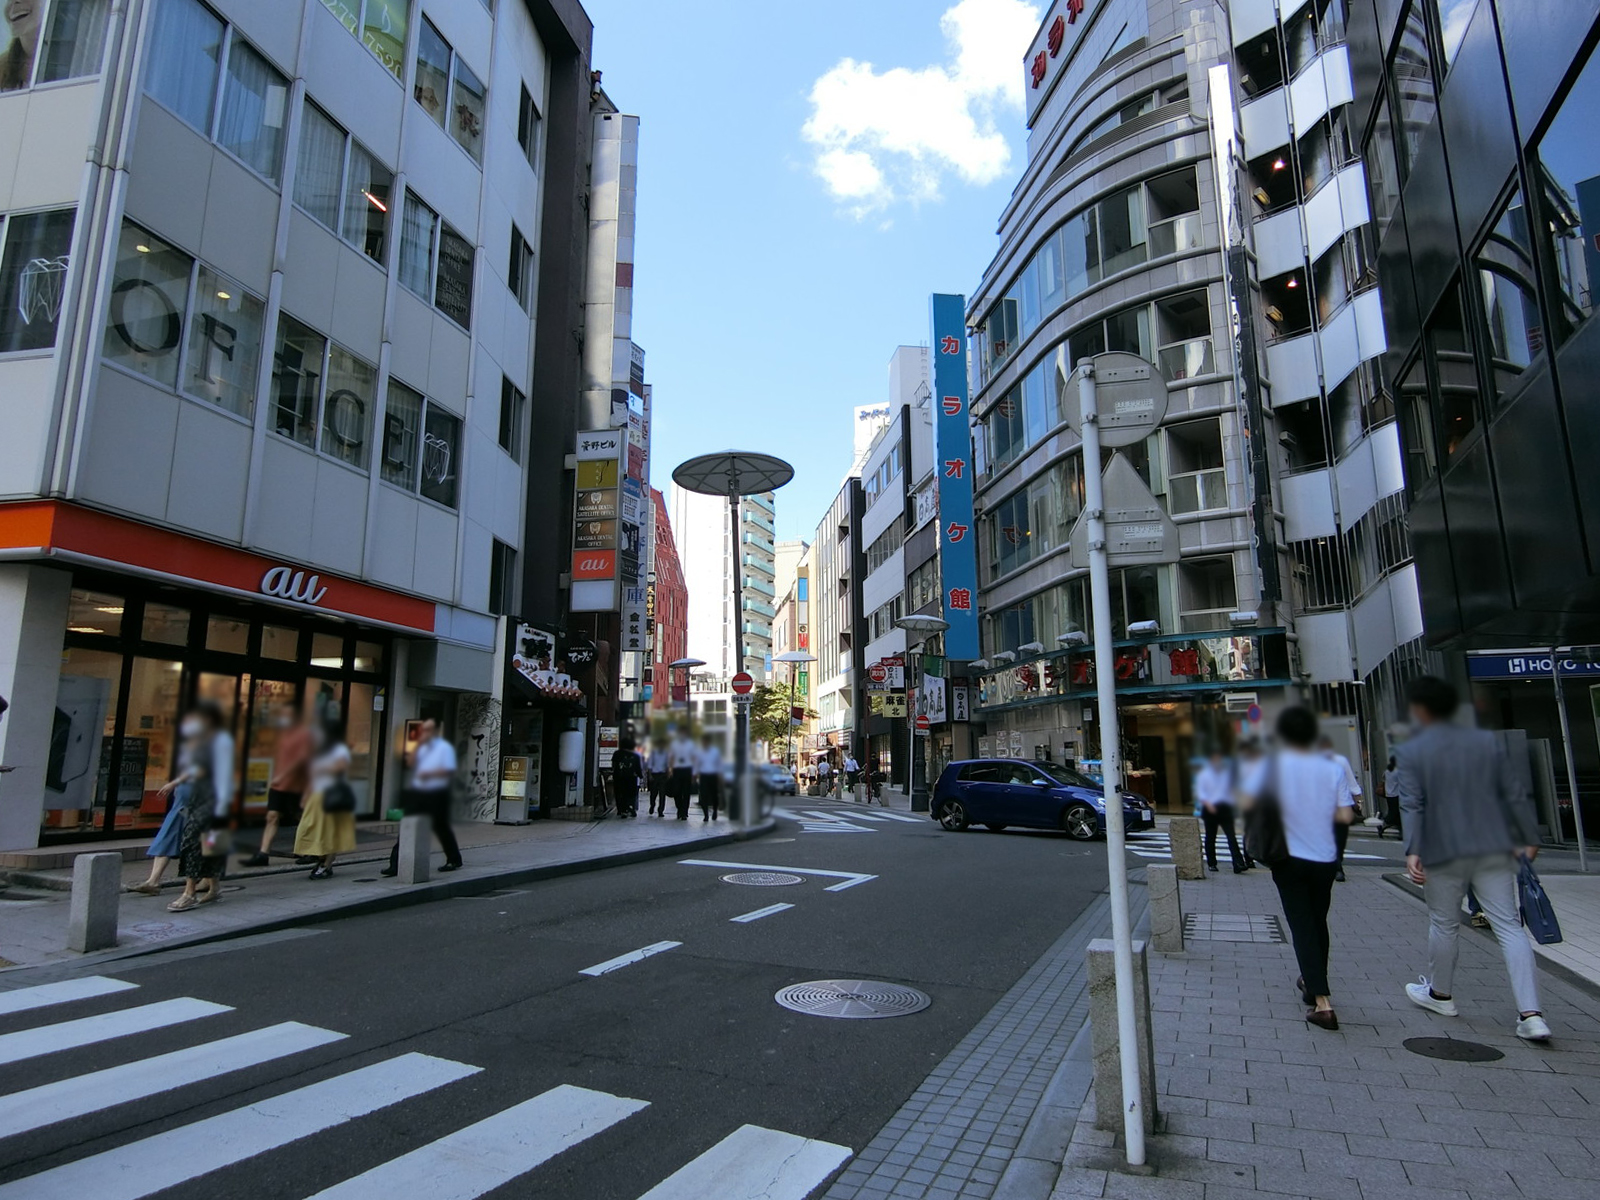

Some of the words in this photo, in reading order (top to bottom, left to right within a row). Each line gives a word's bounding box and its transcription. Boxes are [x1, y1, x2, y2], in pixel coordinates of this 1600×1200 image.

[941, 335, 971, 611] カラオケ館
[580, 558, 609, 571] au
[261, 566, 328, 605] au
[886, 695, 905, 706] 麻雀
[892, 707, 900, 716] 北
